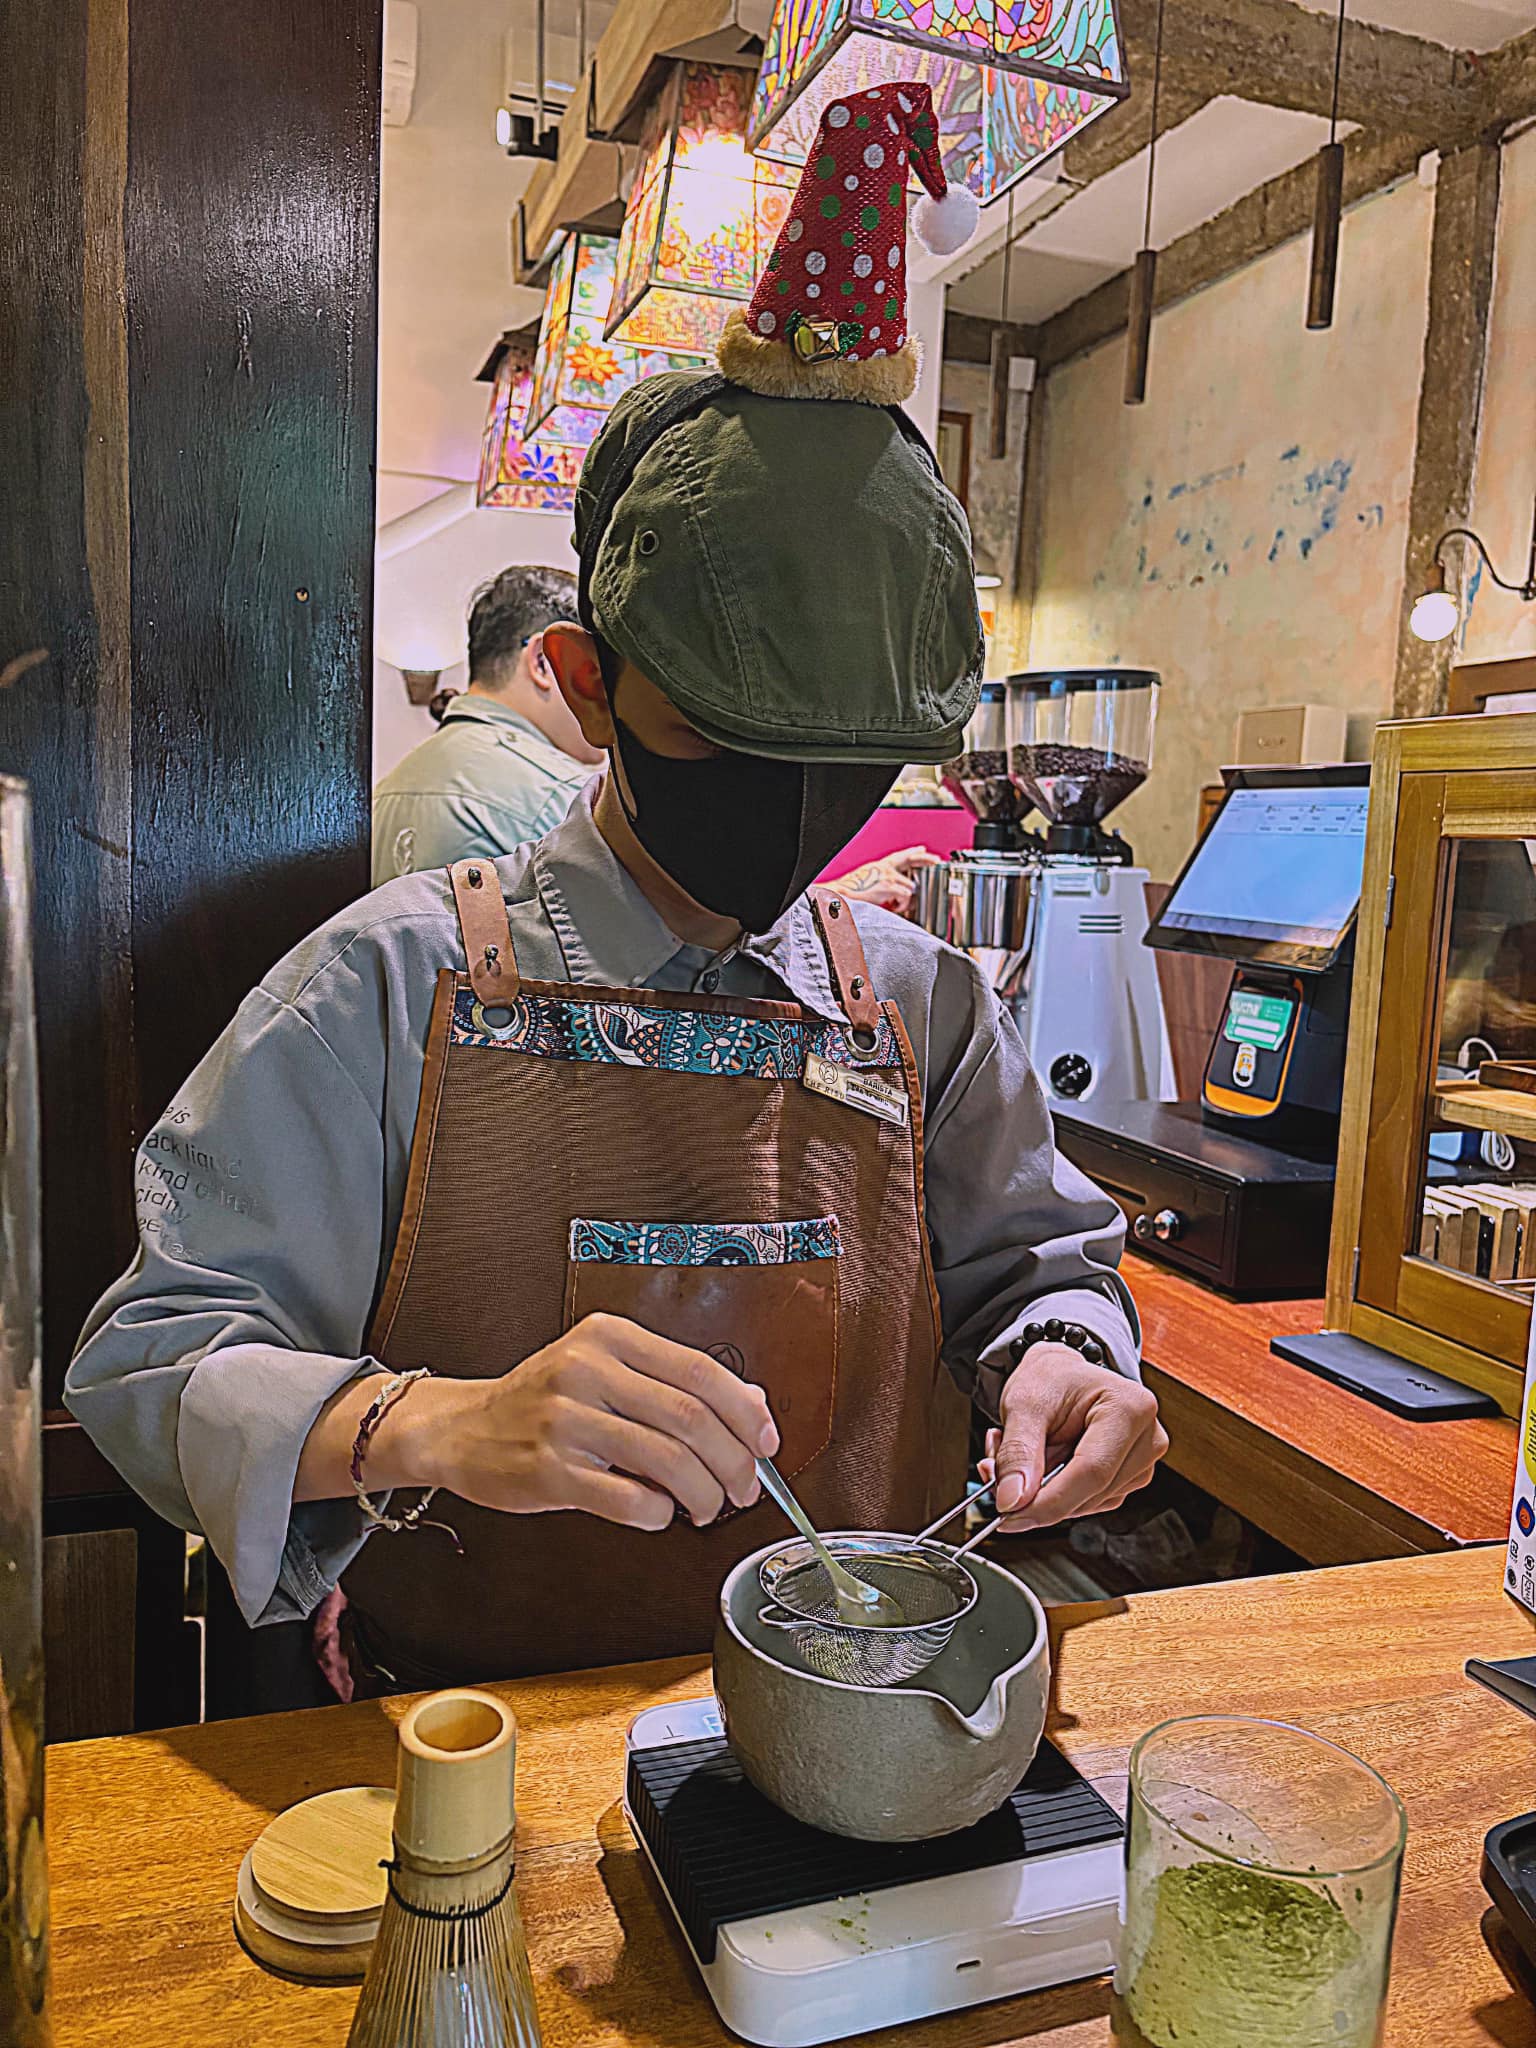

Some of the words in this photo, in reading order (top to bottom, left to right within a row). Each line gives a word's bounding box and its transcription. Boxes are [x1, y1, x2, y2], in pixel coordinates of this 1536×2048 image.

[864, 1078, 893, 1096] BARISTA
[170, 1106, 191, 1124] is
[138, 1157, 189, 1190] kind
